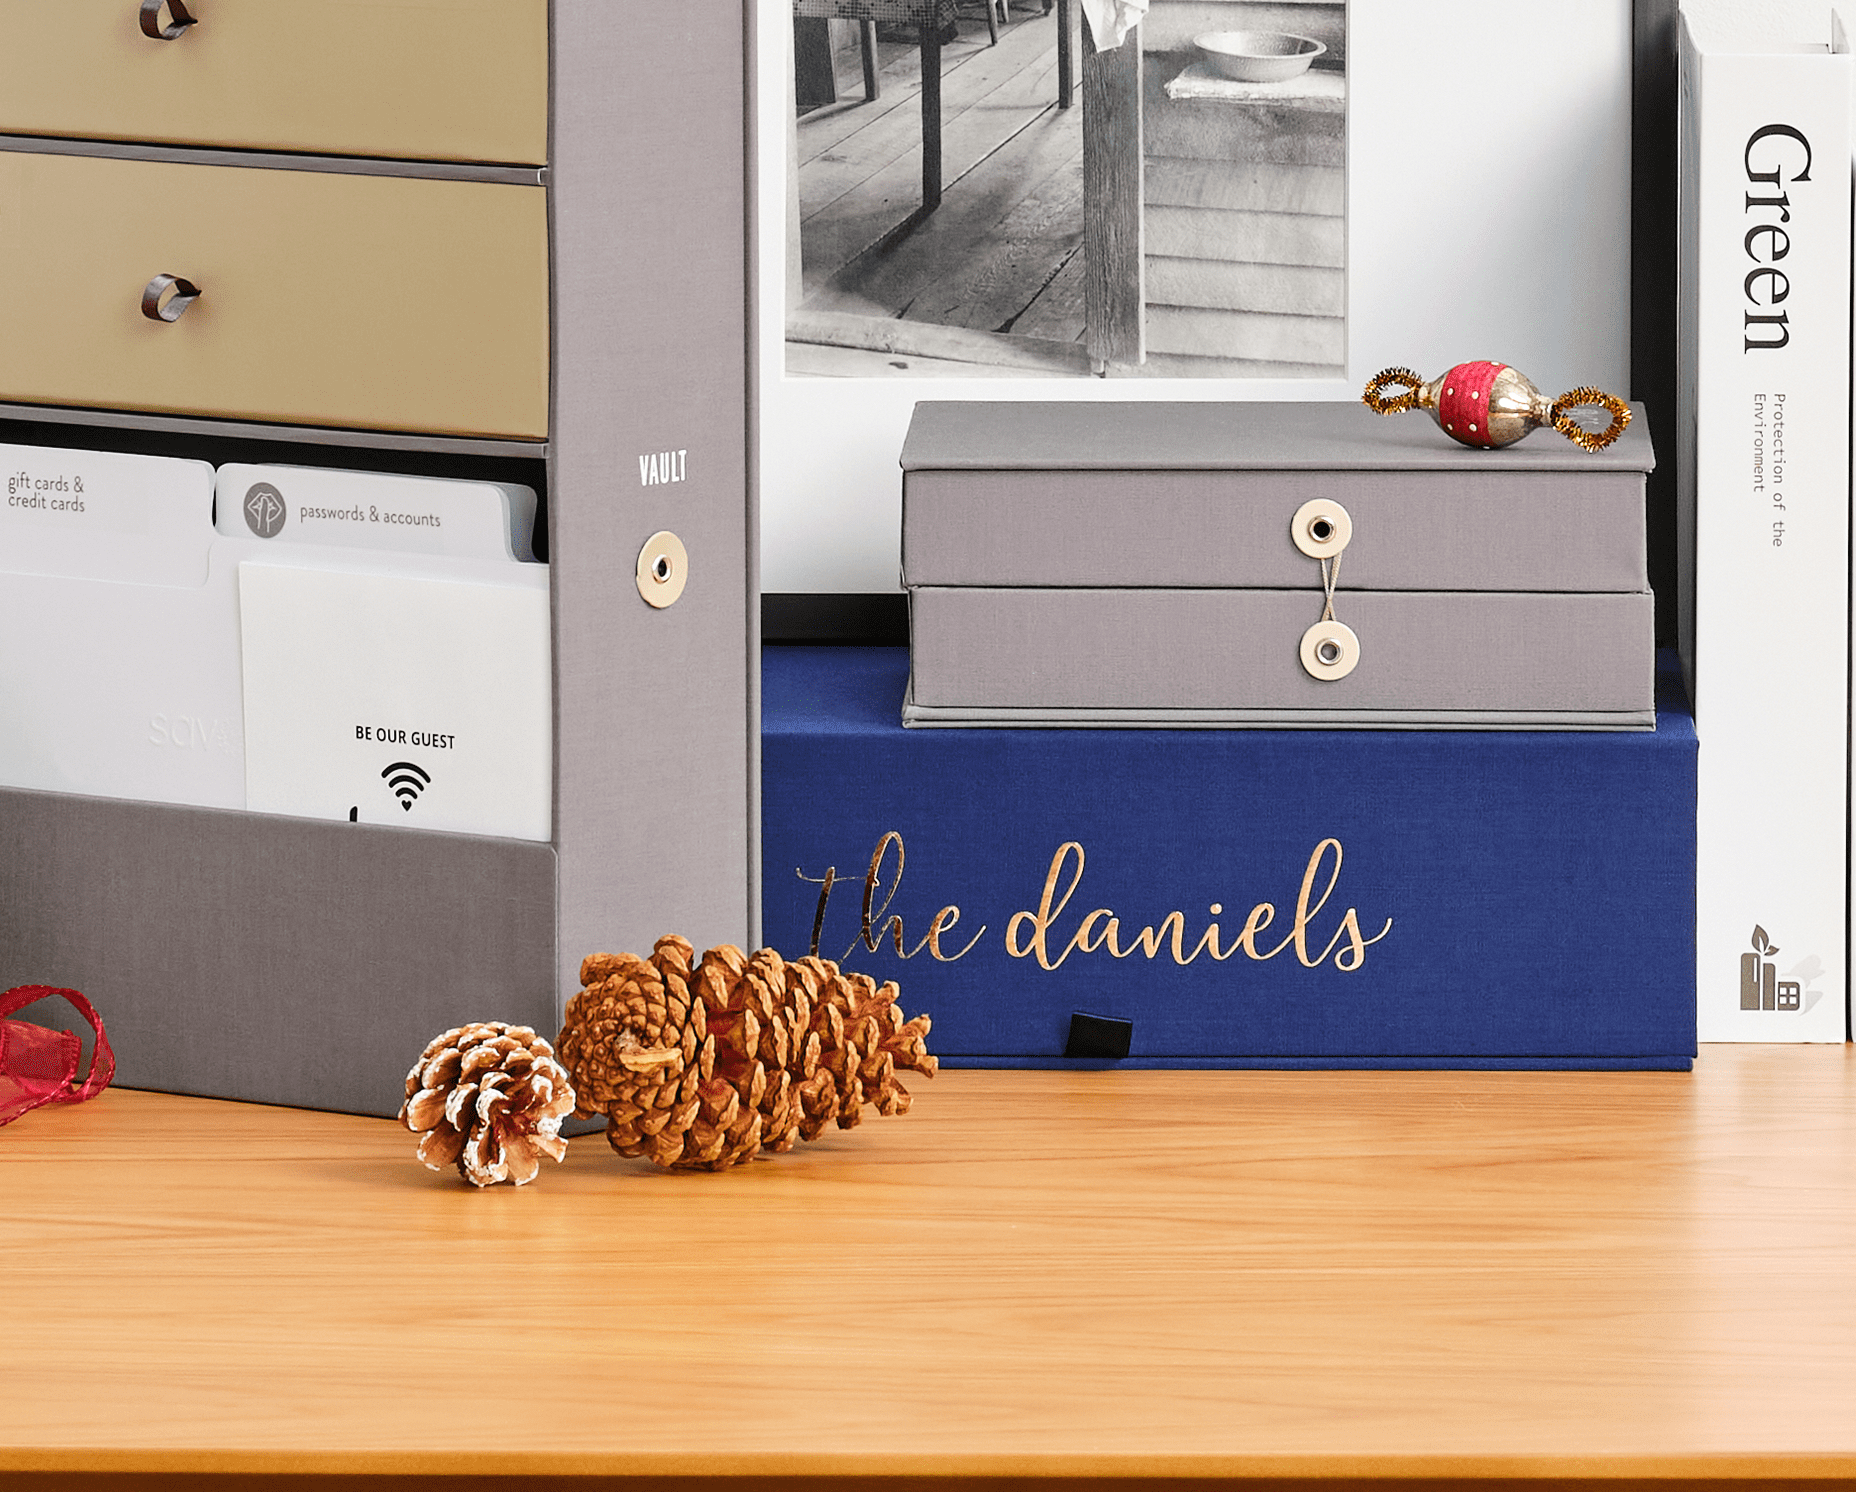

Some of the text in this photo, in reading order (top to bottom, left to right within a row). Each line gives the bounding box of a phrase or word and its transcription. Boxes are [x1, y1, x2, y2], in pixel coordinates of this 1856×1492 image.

[1743, 123, 1812, 355] Green
[1754, 393, 1766, 492] Environment
[7, 471, 85, 494] gift cards &
[639, 449, 688, 487] VAULT
[1772, 393, 1786, 547] Protection of the
[8, 492, 86, 512] credit cards
[300, 505, 441, 527] passwords & accounts
[355, 725, 455, 750] BE OUR GUEST
[795, 830, 1393, 972] the daniels
